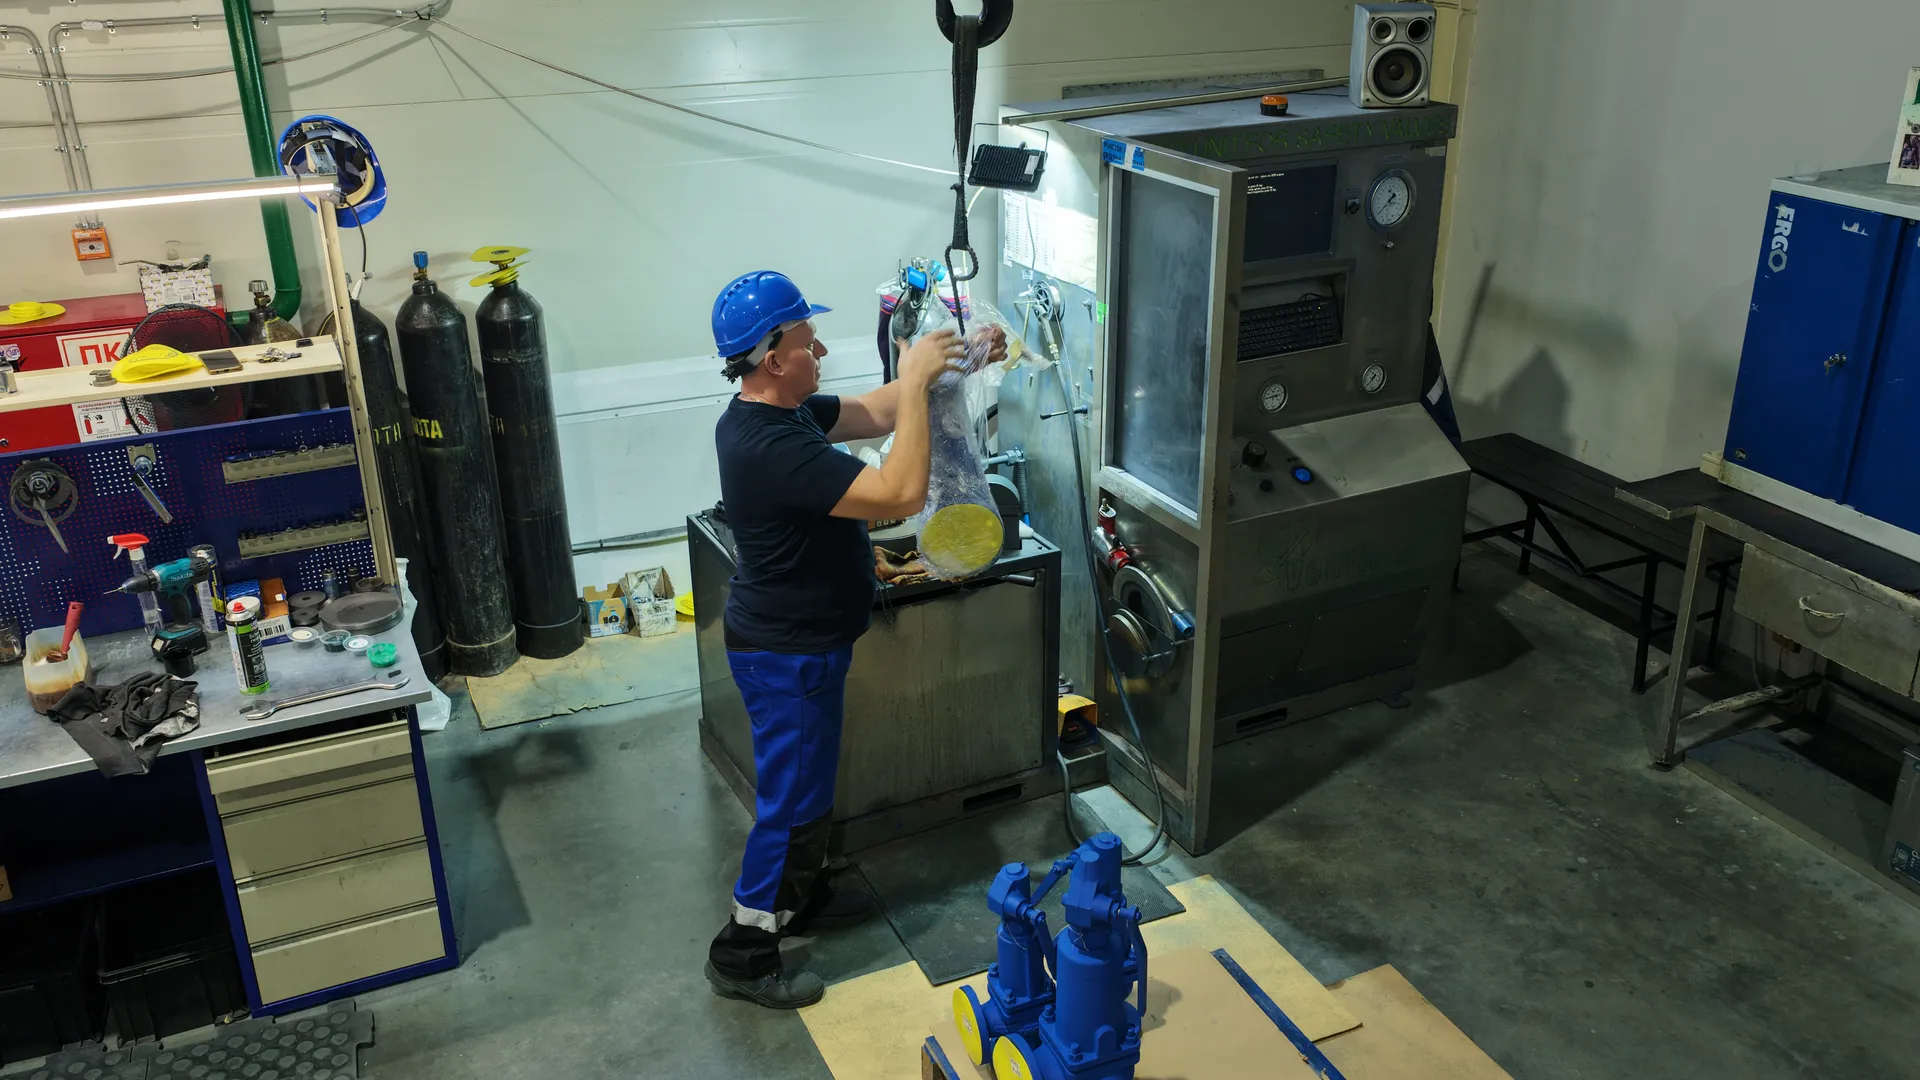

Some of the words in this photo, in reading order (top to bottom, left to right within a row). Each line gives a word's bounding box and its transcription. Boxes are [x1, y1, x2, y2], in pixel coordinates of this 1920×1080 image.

[1245, 129, 1289, 153] FOR
[1296, 121, 1373, 148] SAFETY
[1382, 114, 1450, 140] VALVES
[1768, 204, 1795, 273] ERGO
[79, 342, 121, 365] ПК
